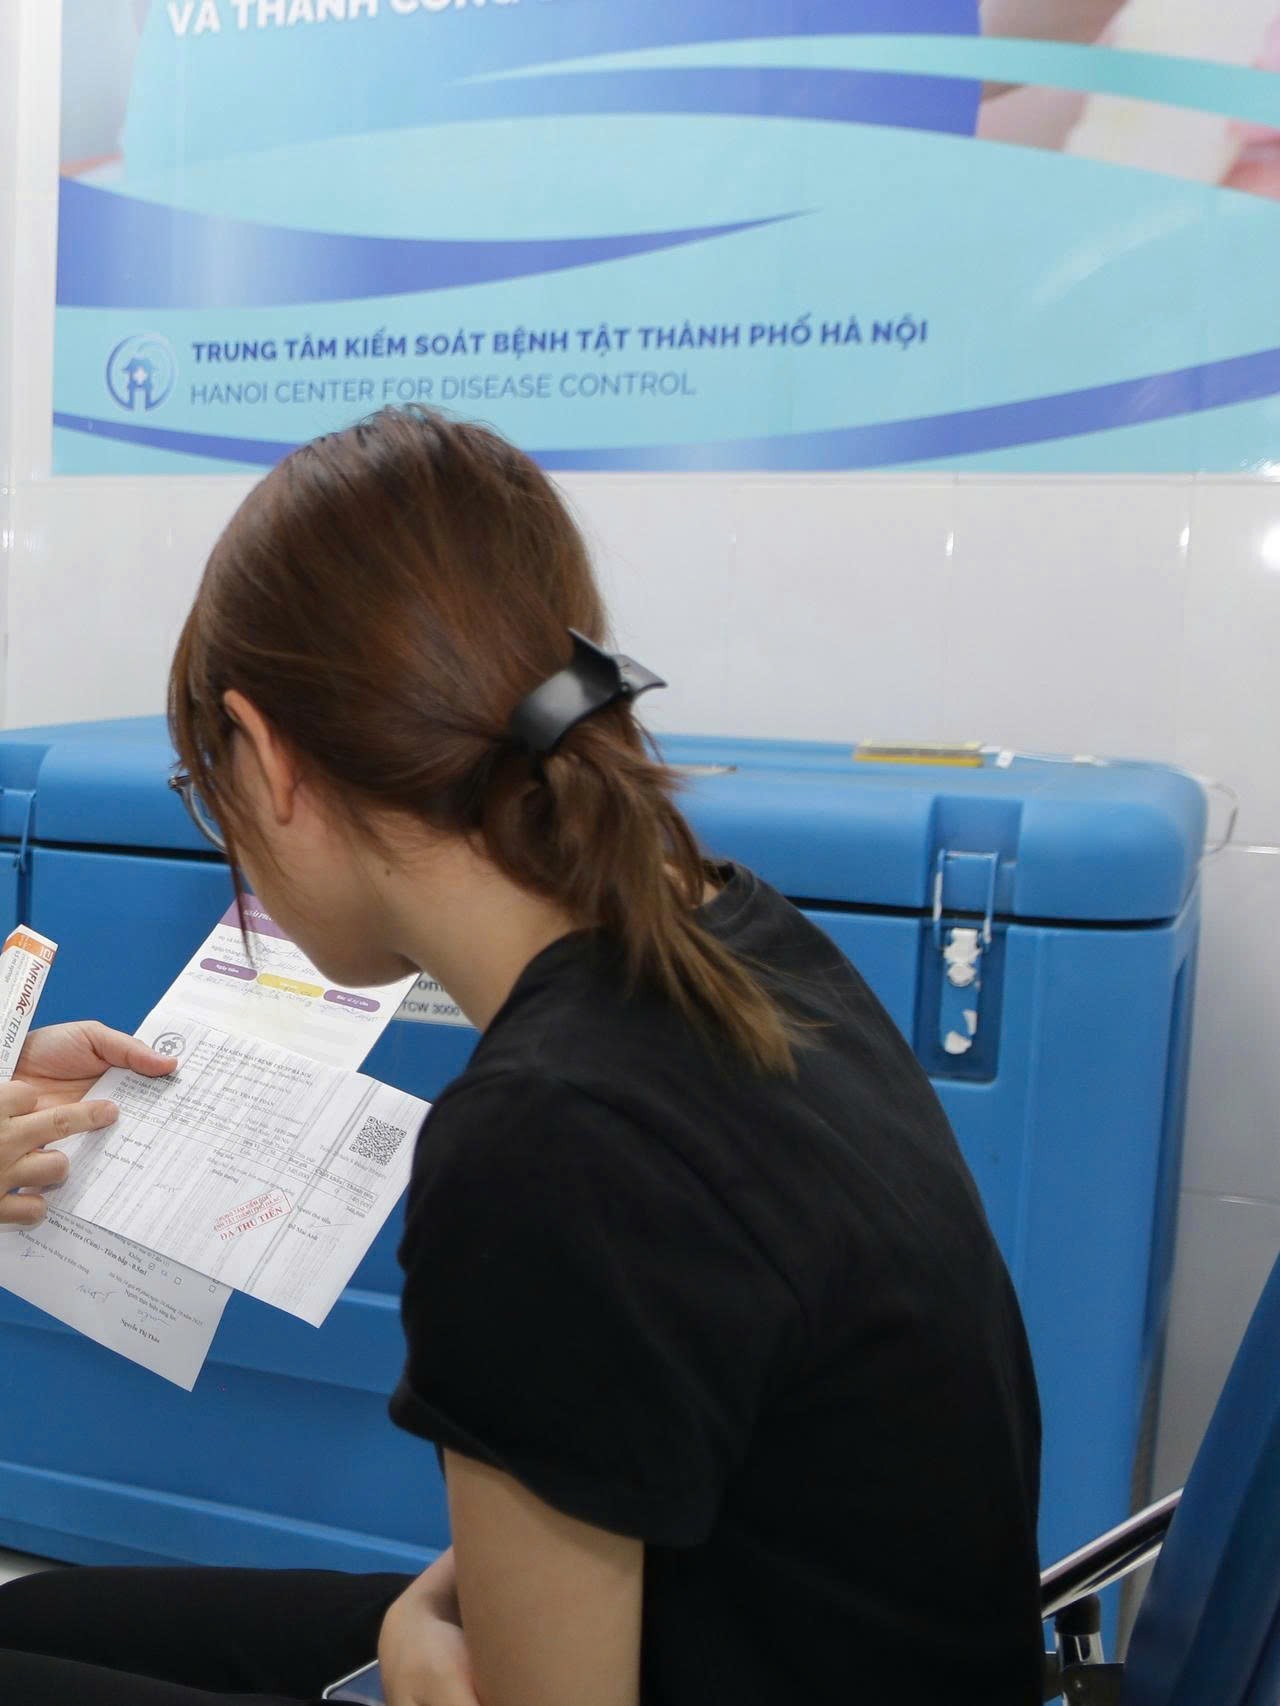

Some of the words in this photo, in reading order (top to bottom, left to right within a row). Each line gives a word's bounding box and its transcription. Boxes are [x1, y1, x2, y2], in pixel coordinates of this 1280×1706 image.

[192, 341, 278, 363] TRUNG
[285, 332, 337, 360] TÂM
[344, 327, 406, 359] KIỂM
[414, 329, 485, 357] SOÁT
[493, 325, 567, 360] BỆNH
[576, 322, 631, 357] TẬT
[638, 320, 740, 350] THÀNH
[750, 312, 812, 346] PHỐ
[821, 315, 862, 345] HÀ
[872, 314, 928, 350] NỘI
[190, 382, 267, 405] HANOI
[274, 378, 375, 403] CENTER
[382, 377, 433, 401] FOR
[441, 374, 553, 400] DISEASE
[559, 370, 697, 398] CONTROL
[15, 959, 44, 1015] INFLUVAC
[2, 1015, 24, 1049] TETRA
[70, 1229, 83, 1240] Tetra
[237, 1218, 258, 1233] THU
